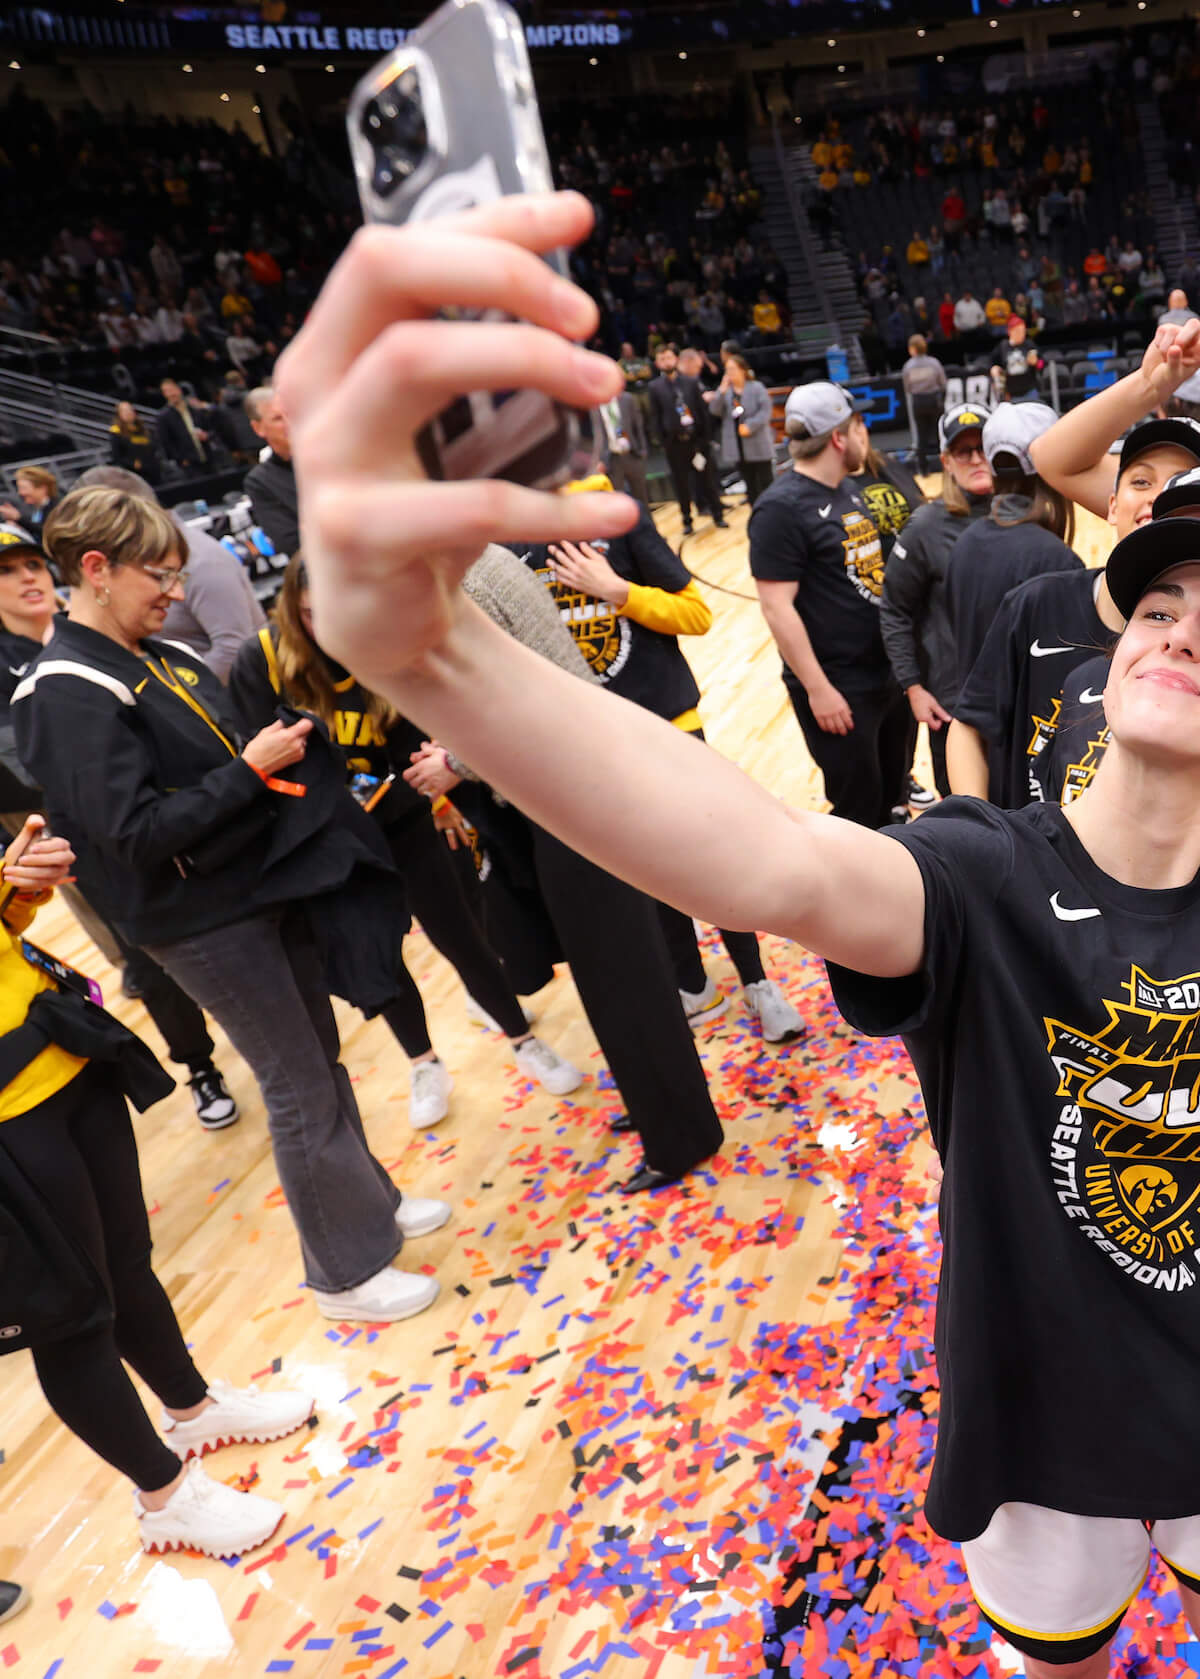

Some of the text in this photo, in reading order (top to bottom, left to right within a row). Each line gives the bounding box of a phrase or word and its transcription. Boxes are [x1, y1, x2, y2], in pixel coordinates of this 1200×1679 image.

[226, 24, 340, 50] SEATTLE
[524, 23, 621, 47] MPIONS
[1058, 1032, 1112, 1062] FINAL
[1050, 1104, 1092, 1220] SEATTLE
[1085, 1163, 1165, 1263] UNIVERSI
[1166, 1220, 1195, 1254] OF
